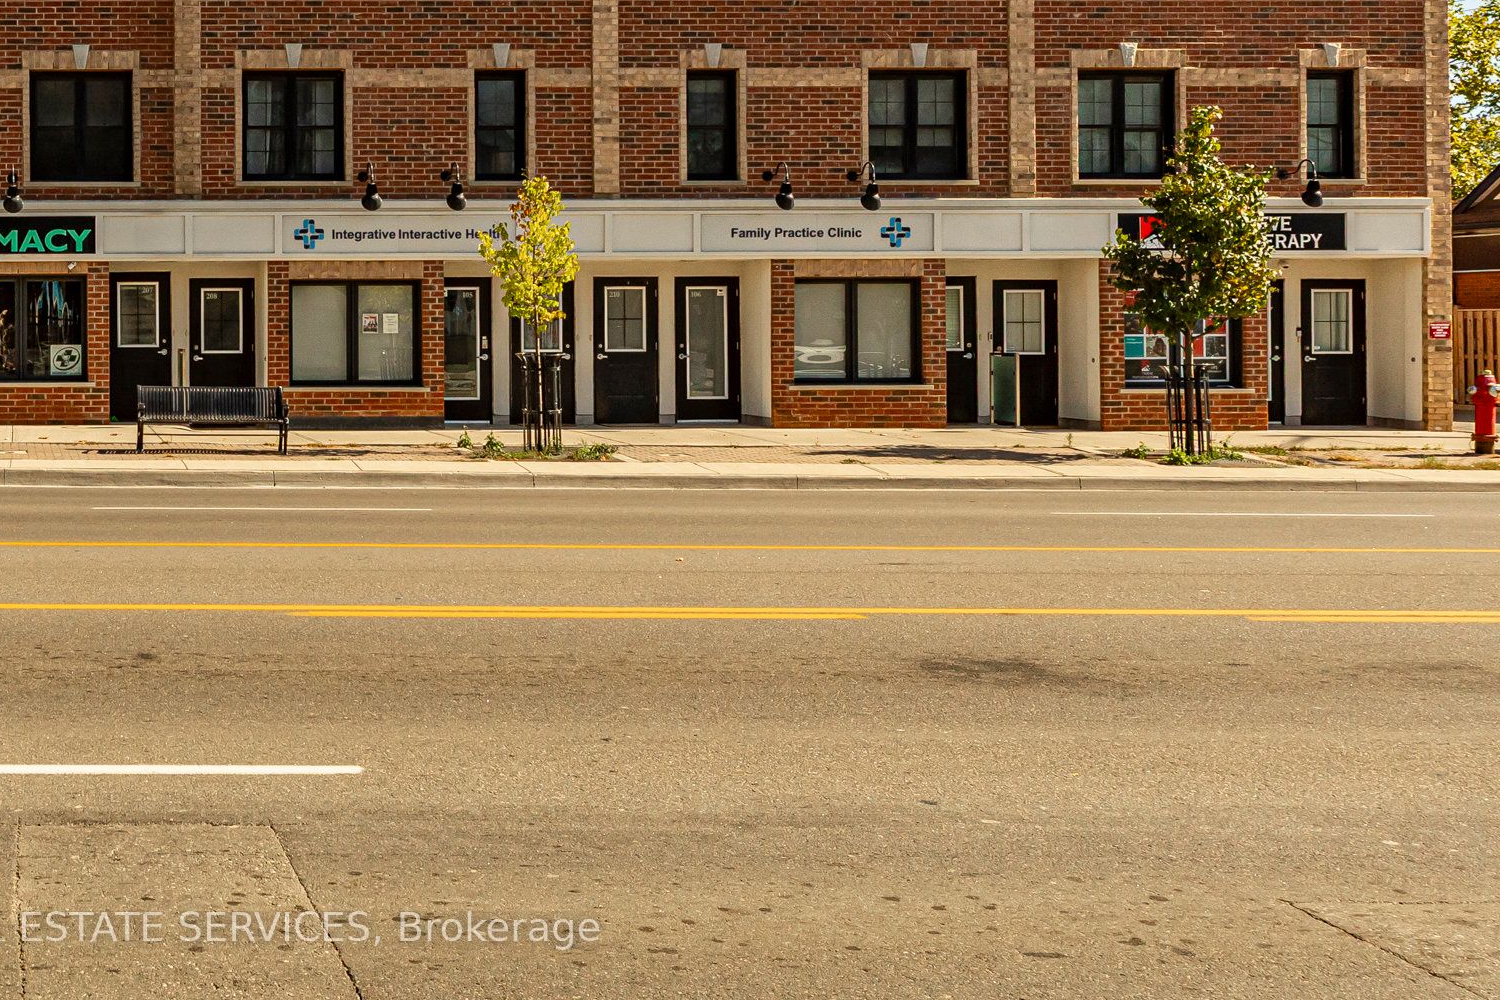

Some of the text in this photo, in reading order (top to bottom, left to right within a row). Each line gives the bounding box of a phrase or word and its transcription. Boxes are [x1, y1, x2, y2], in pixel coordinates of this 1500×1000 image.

[331, 229, 395, 241] Integrative
[398, 228, 462, 239] Interactive
[731, 227, 862, 240] Family Practice Clinic
